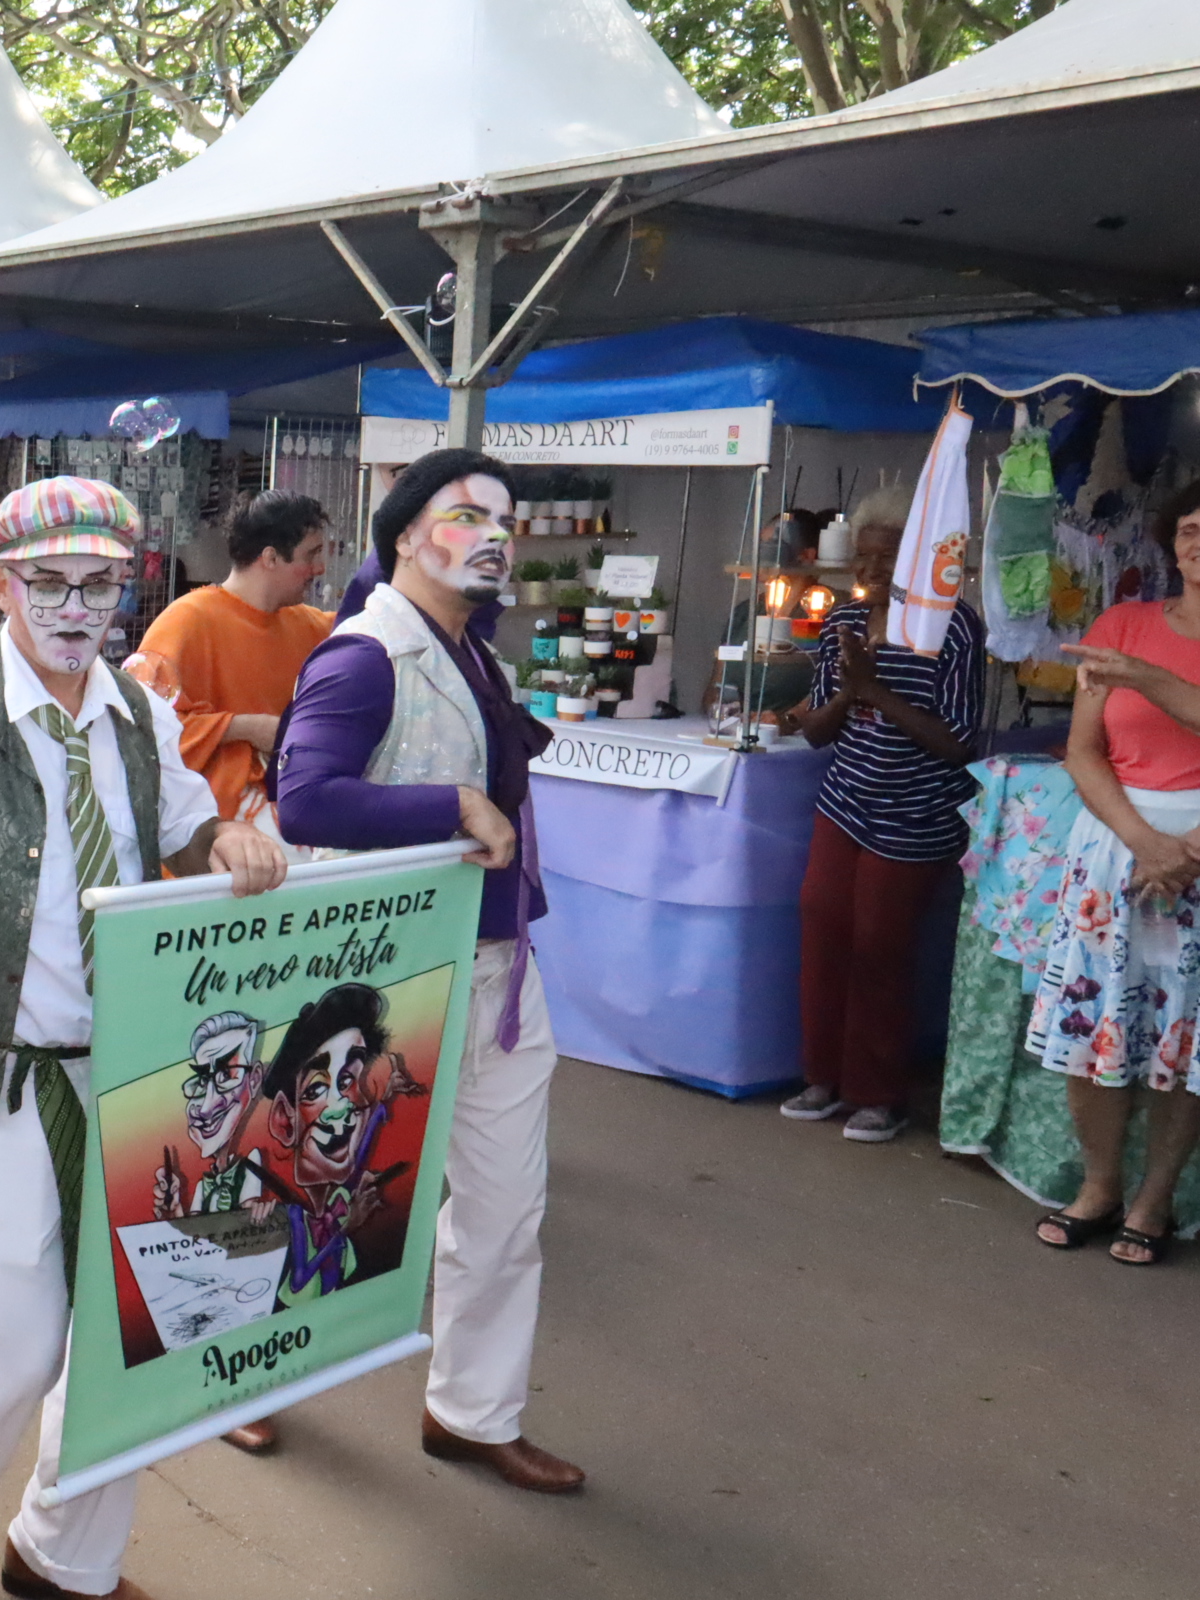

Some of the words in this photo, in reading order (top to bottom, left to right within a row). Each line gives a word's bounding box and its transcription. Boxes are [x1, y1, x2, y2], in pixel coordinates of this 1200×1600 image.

[433, 422, 534, 447] FMAS
[539, 422, 575, 446] DA
[579, 419, 634, 446] ART
[651, 428, 708, 441] @formasdaart
[512, 451, 561, 461] CONCRETO
[645, 444, 662, 456] (19)
[664, 444, 671, 455] 9
[672, 444, 720, 455] 9764-4005
[539, 737, 691, 781] CONCRETO
[154, 917, 267, 956] PINTOR
[278, 912, 295, 936] E
[303, 889, 437, 932] APRENDIZ
[184, 956, 229, 1006] Un
[235, 953, 300, 995] vero
[306, 922, 398, 980] artista
[138, 1234, 203, 1257] PINTOR
[208, 1232, 219, 1244] E
[171, 1253, 191, 1262] Un
